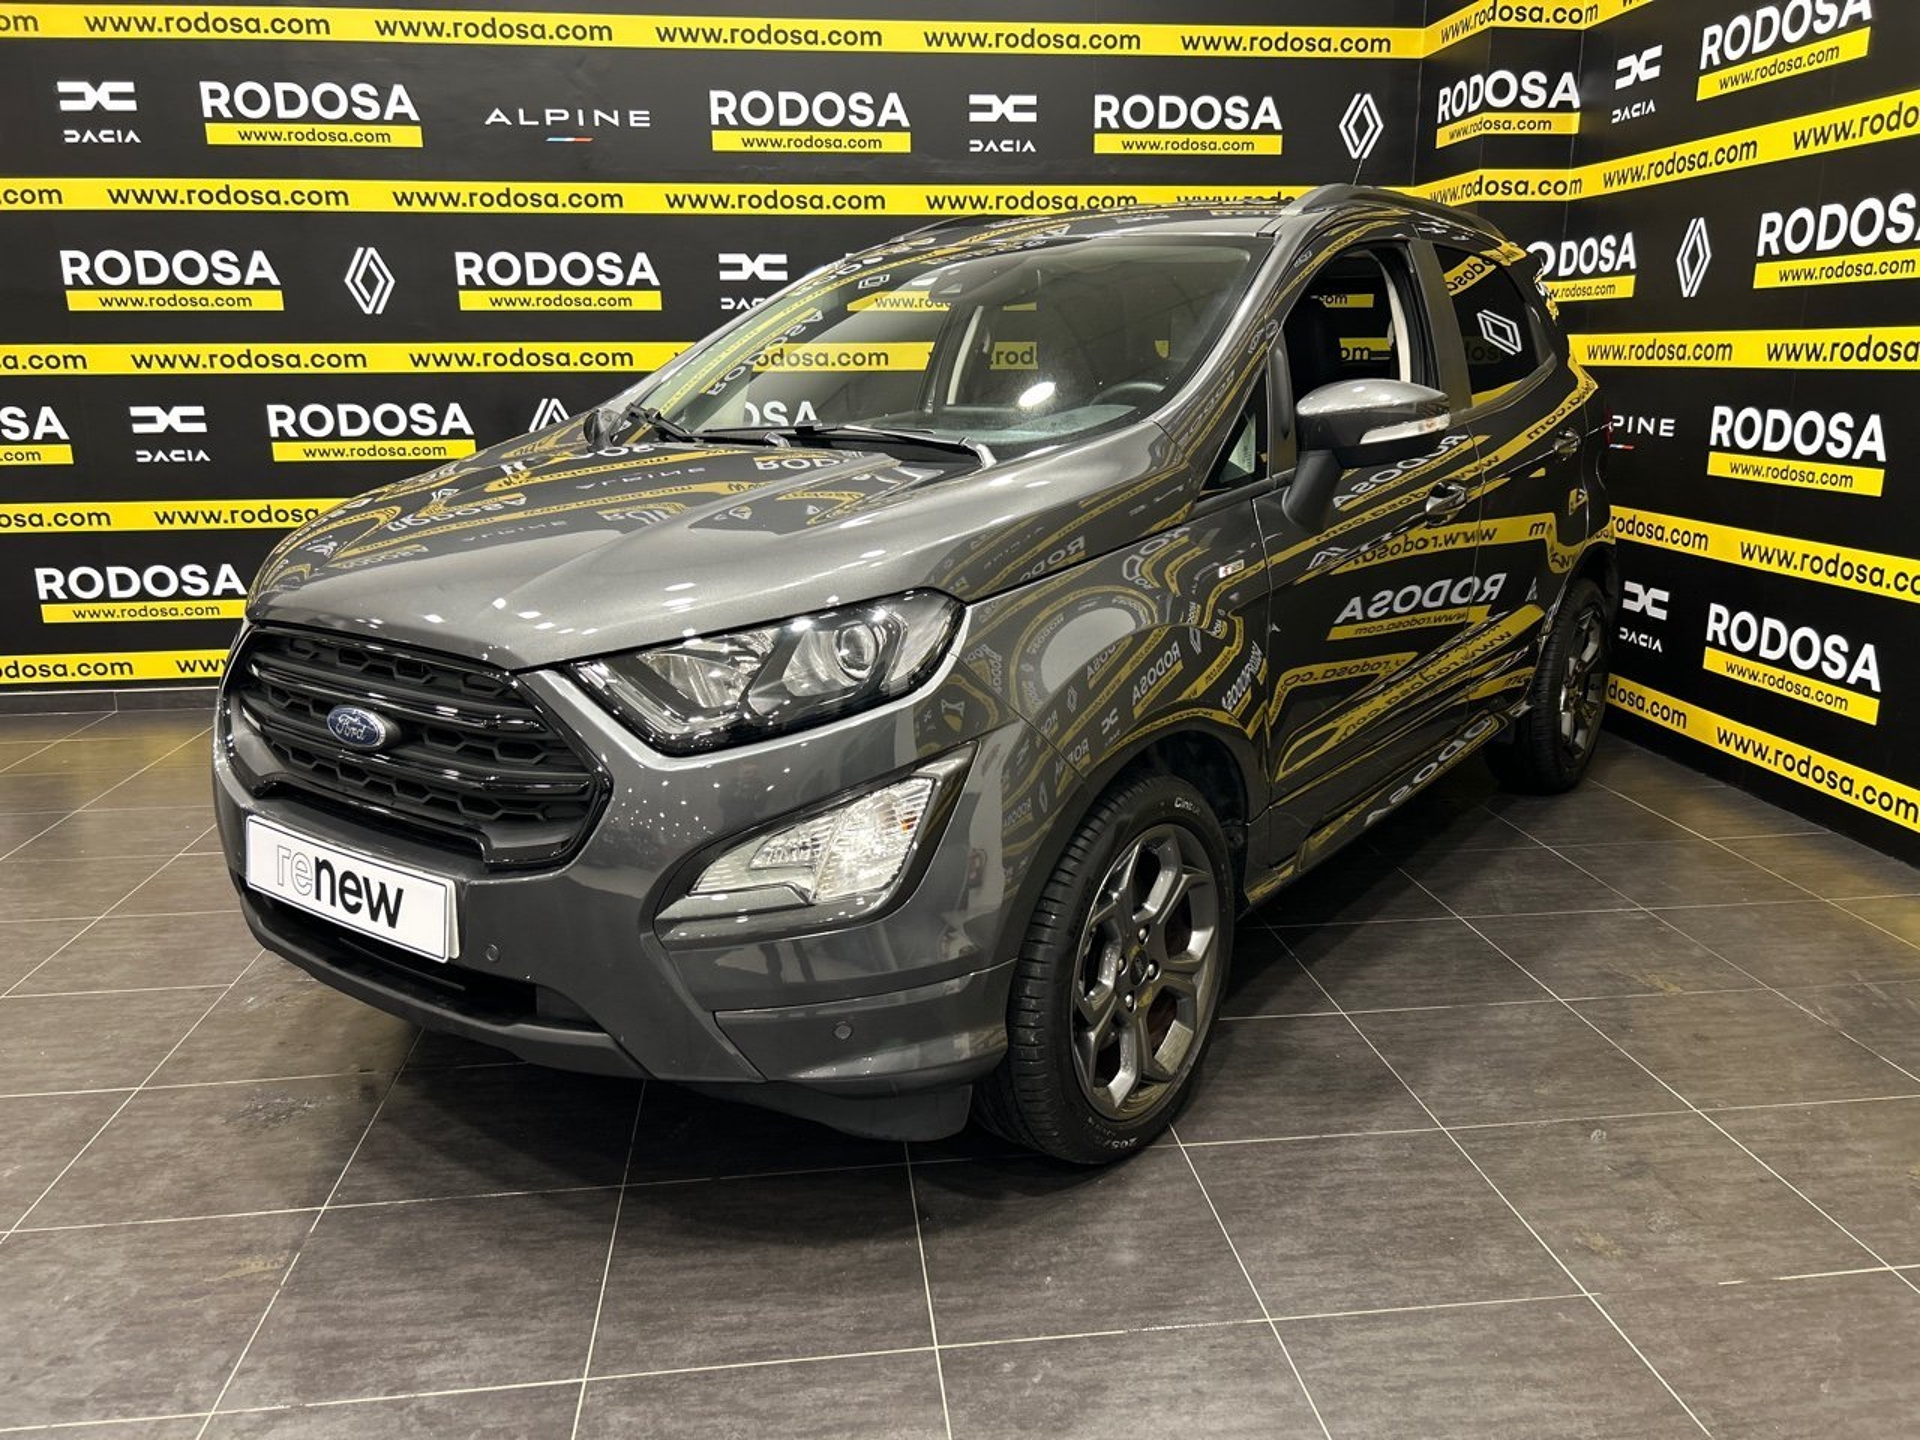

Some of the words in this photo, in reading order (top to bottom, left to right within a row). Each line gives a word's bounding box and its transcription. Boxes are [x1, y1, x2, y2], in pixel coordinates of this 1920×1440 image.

[84, 12, 331, 35] www.rodosa.com
[375, 17, 613, 41] www.rodosa.com
[656, 21, 883, 46] www.rodosa.com
[924, 28, 1141, 50] www.rodosa.com
[1181, 31, 1391, 54] www.rodosa.com
[1441, 0, 1598, 43] www.rodosa.com
[1719, 45, 1840, 90] www.rodosa.com
[200, 81, 420, 120] RODOSA
[709, 90, 910, 127] RODOSA
[1437, 70, 1581, 124] RODOSA
[484, 108, 651, 127] ALPINE
[1094, 94, 1282, 130] RODOSA
[1611, 99, 1656, 124] DACIA
[64, 129, 141, 143] DACIA
[237, 128, 391, 144] www.rodosa.com
[741, 134, 882, 150] www.rodosa.com
[1449, 116, 1552, 141] www.rodosa.com
[969, 140, 1036, 152] DACIA
[1122, 136, 1255, 152] www.rodosa.com
[1603, 139, 1757, 188] www.rodosa.com
[107, 183, 349, 206] www.rodosa.com
[393, 187, 624, 209] www.rodosa.com
[666, 189, 886, 211] www.rodosa.com
[925, 191, 1137, 211] www.rodosa.com
[1756, 192, 1920, 257] RODOS
[59, 250, 281, 286] RODOSA
[455, 251, 660, 286] RODOSA
[1779, 258, 1916, 282] www.rodosa.com
[99, 295, 252, 309] www.rodosa.com
[490, 295, 632, 309] www.rodosa.com
[0, 354, 87, 370] a.com
[131, 349, 367, 369] www.rodosa.com
[409, 348, 634, 368] www.rodosa.com
[1587, 337, 1733, 362] www.rodosa.com
[267, 403, 474, 438] RODOSA
[1709, 406, 1886, 462] RODOSA
[136, 450, 210, 462] DACIA
[303, 443, 447, 458] www.rodosa.com
[1729, 460, 1853, 488] www.rodosa.com
[34, 563, 248, 600] RODOSA
[73, 605, 220, 620] www.rodosa.com
[1619, 627, 1663, 653] DACIA
[1705, 603, 1881, 692] RODOSA
[1726, 659, 1848, 711] www.rodosa.com
[336, 713, 367, 740] Ford
[1717, 726, 1919, 824] www.rodosa.com
[276, 845, 404, 929] renew
